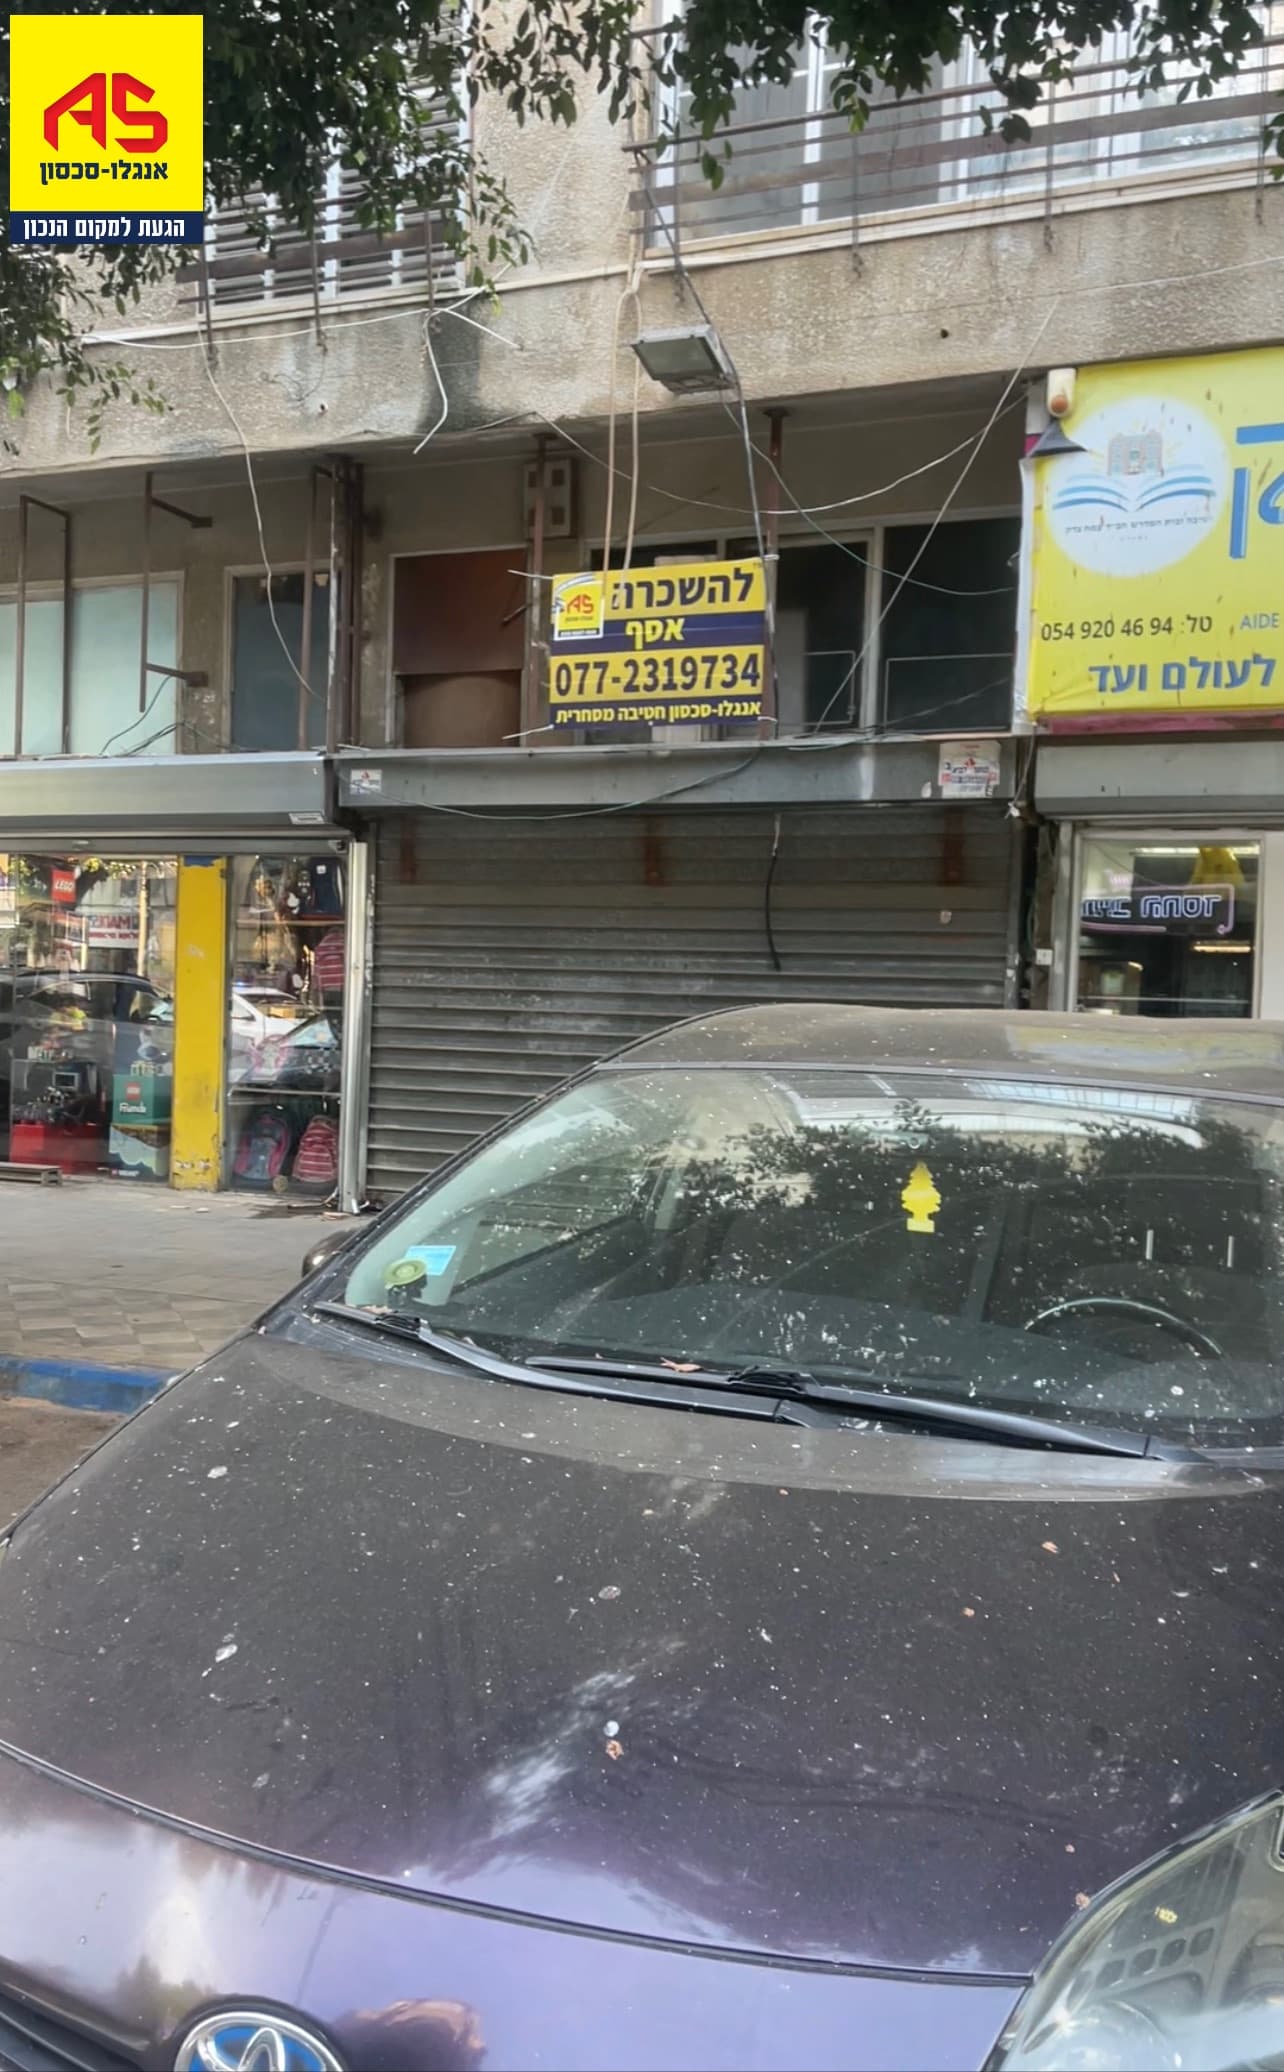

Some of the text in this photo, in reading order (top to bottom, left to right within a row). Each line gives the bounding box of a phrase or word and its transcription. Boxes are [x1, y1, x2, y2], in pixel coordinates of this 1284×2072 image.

[611, 568, 754, 610] להשכרה
[567, 594, 594, 614] AS
[625, 618, 686, 650] אסף
[1041, 614, 1213, 641] טל: 054 920 46 94
[1240, 613, 1280, 630] AIDE
[555, 653, 760, 697] 077-2319734
[1088, 653, 1277, 693] לעולם ועד
[556, 700, 762, 723] אנגלו-סכסון חטיבה מסחרית
[54, 879, 74, 892] LEGO
